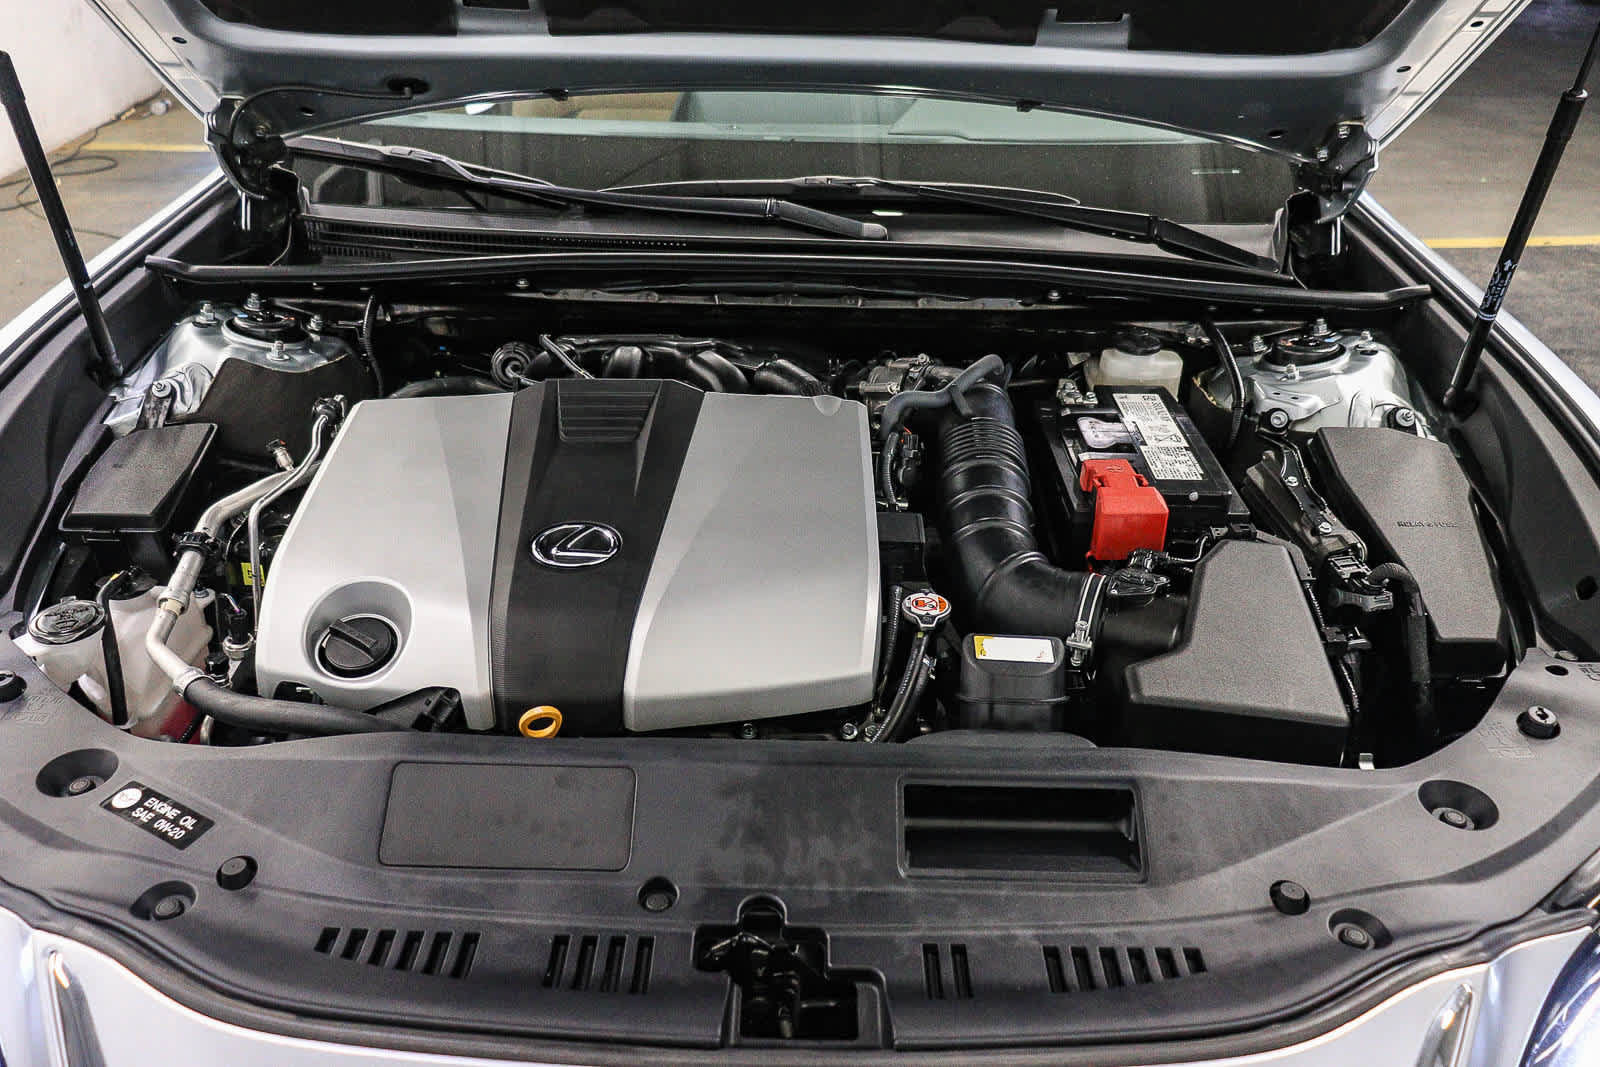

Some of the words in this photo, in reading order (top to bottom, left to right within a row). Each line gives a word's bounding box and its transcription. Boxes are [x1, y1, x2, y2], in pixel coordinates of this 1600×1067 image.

[131, 807, 156, 823] SAE
[153, 819, 186, 840] 0W-20
[143, 797, 181, 820] ENGINE
[179, 815, 198, 831] OIL
